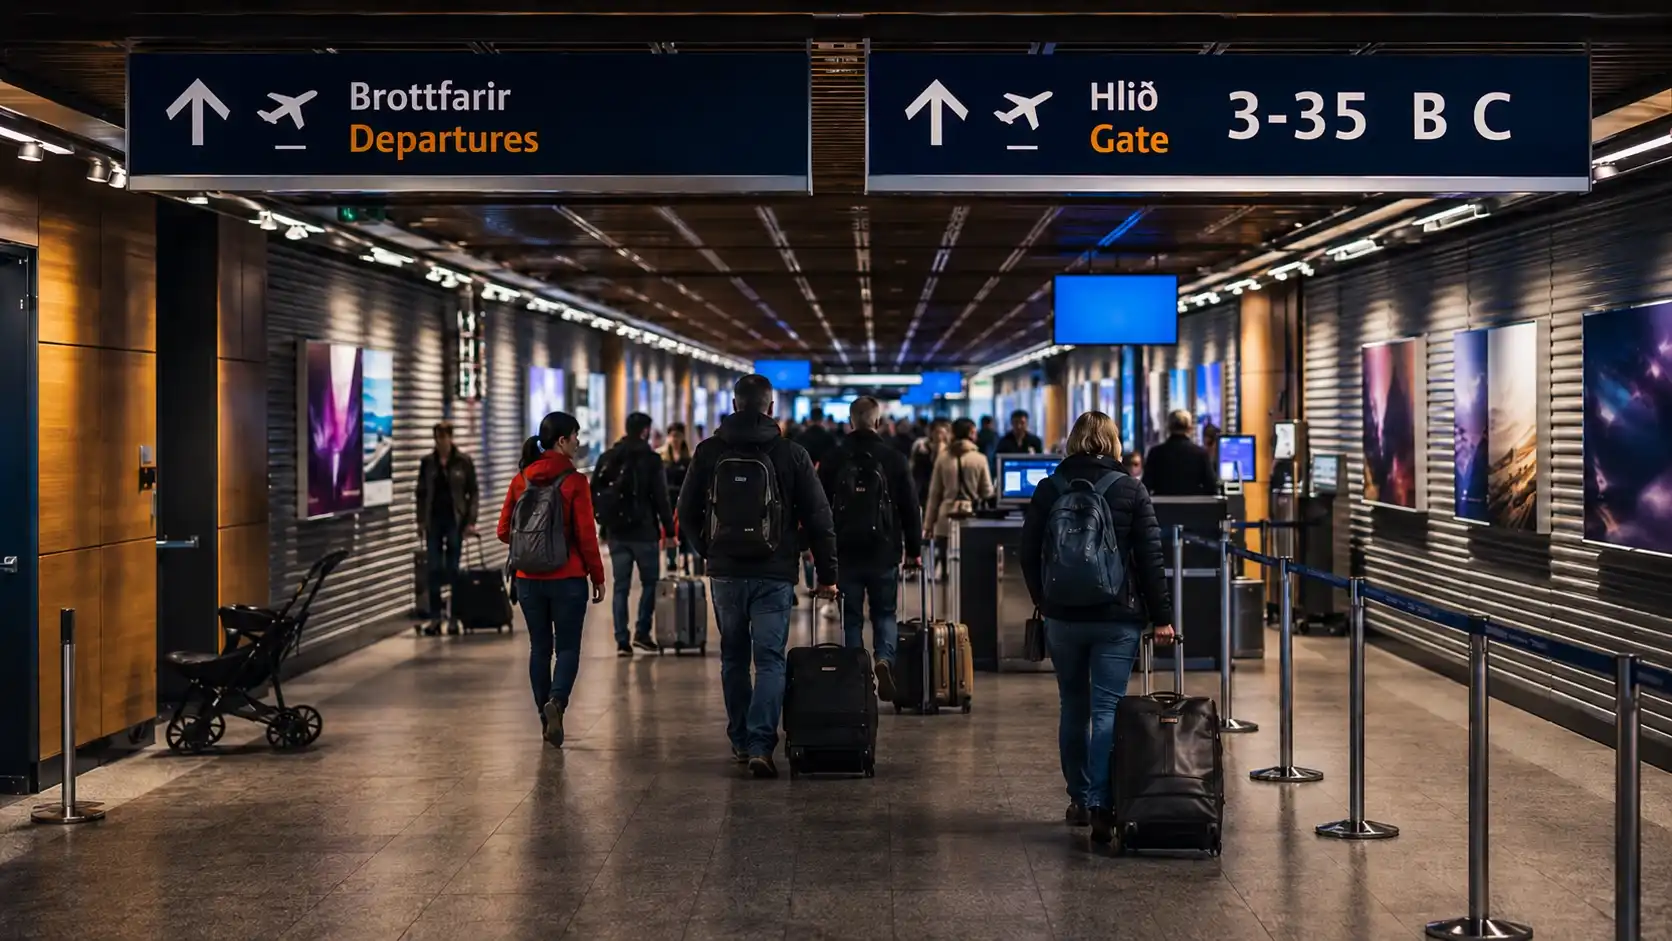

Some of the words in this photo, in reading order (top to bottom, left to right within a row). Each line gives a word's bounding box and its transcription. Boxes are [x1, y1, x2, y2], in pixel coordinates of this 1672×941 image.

[350, 80, 511, 111] Brottfarir
[1091, 80, 1158, 111] Hlið
[1228, 90, 1367, 141] 3-35
[1413, 91, 1448, 140] B
[1473, 91, 1512, 141] C
[350, 124, 539, 161] Departures
[1090, 123, 1169, 154] Gate
